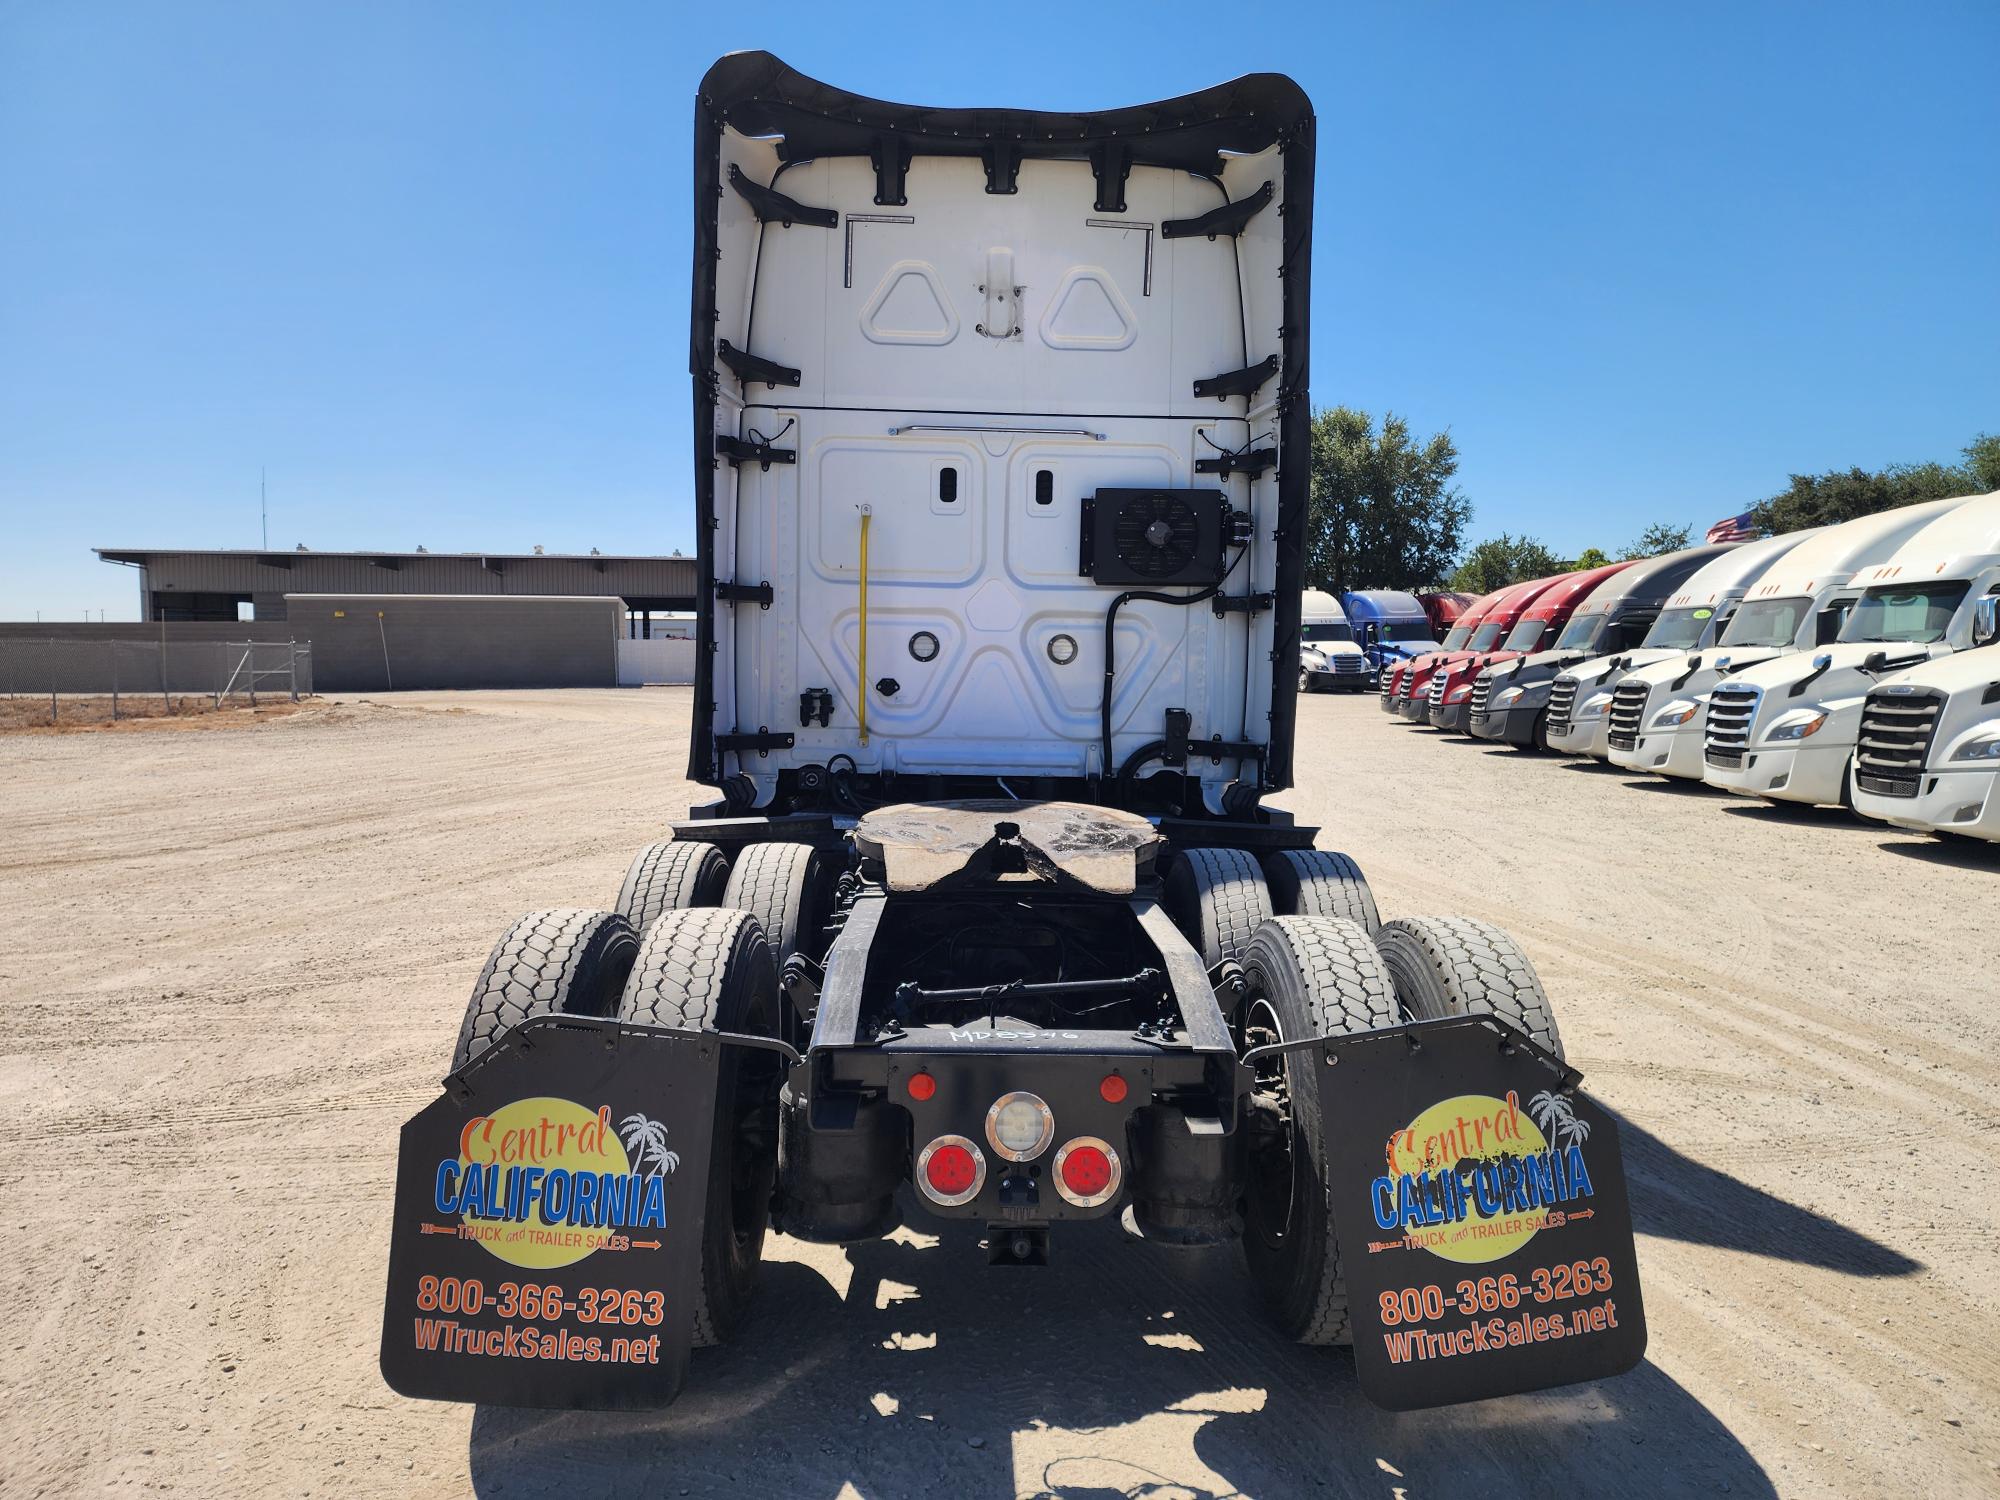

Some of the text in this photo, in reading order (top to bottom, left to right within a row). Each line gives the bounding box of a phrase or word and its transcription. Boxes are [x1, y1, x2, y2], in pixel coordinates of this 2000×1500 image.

[460, 1105, 611, 1168] Central
[1386, 1090, 1524, 1177] Central
[436, 1159, 667, 1229] CALIFORNIA
[1371, 1145, 1593, 1230] CALIFORNIA
[456, 1224, 629, 1251] TRUCK and TRAILER SALES
[1403, 1211, 1565, 1250] TRUCK and TRAILER SALES
[417, 1275, 664, 1325] 800-366-3263
[1379, 1257, 1613, 1325] 800-366-3263
[414, 1318, 661, 1365] WTruckSales.net
[1384, 1298, 1618, 1364] WTruckSales.net
